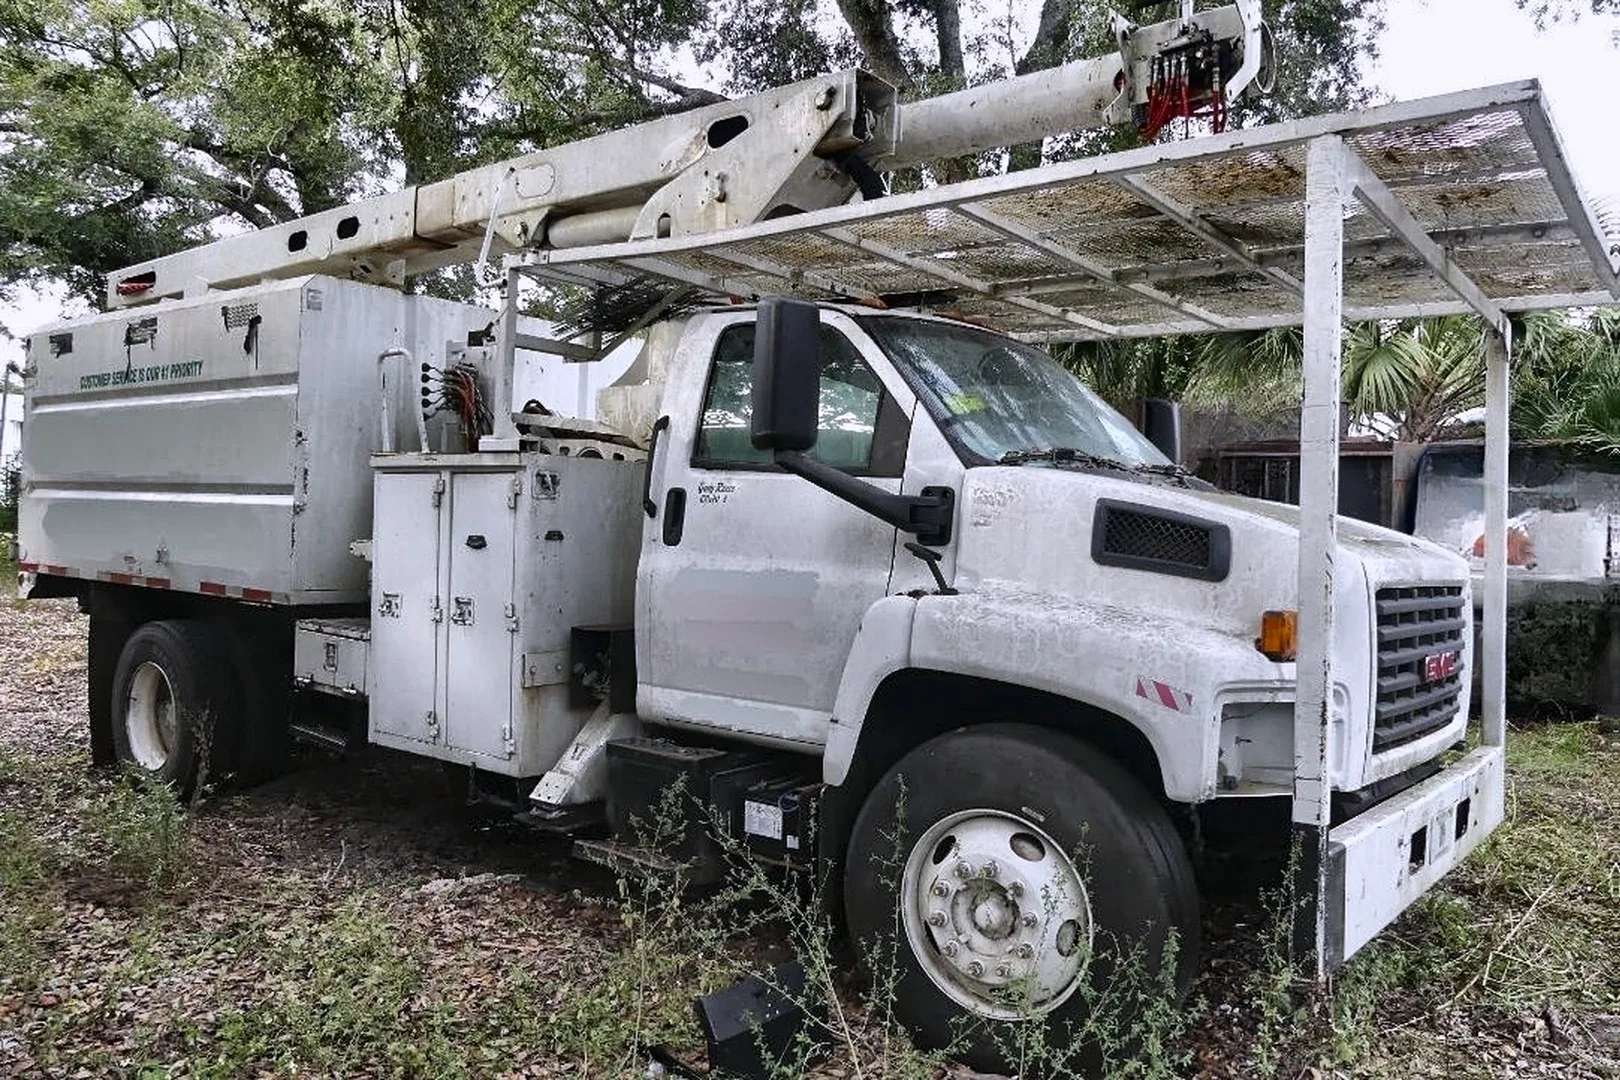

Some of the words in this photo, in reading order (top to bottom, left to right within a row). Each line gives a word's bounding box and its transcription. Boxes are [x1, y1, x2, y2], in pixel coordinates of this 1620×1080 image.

[80, 373, 111, 389] CUSTOMER
[112, 369, 137, 385] SERVCE
[139, 367, 145, 382] IS
[146, 366, 160, 381] OUR
[170, 360, 204, 378] PRIORITY
[1425, 652, 1455, 681] GMC
